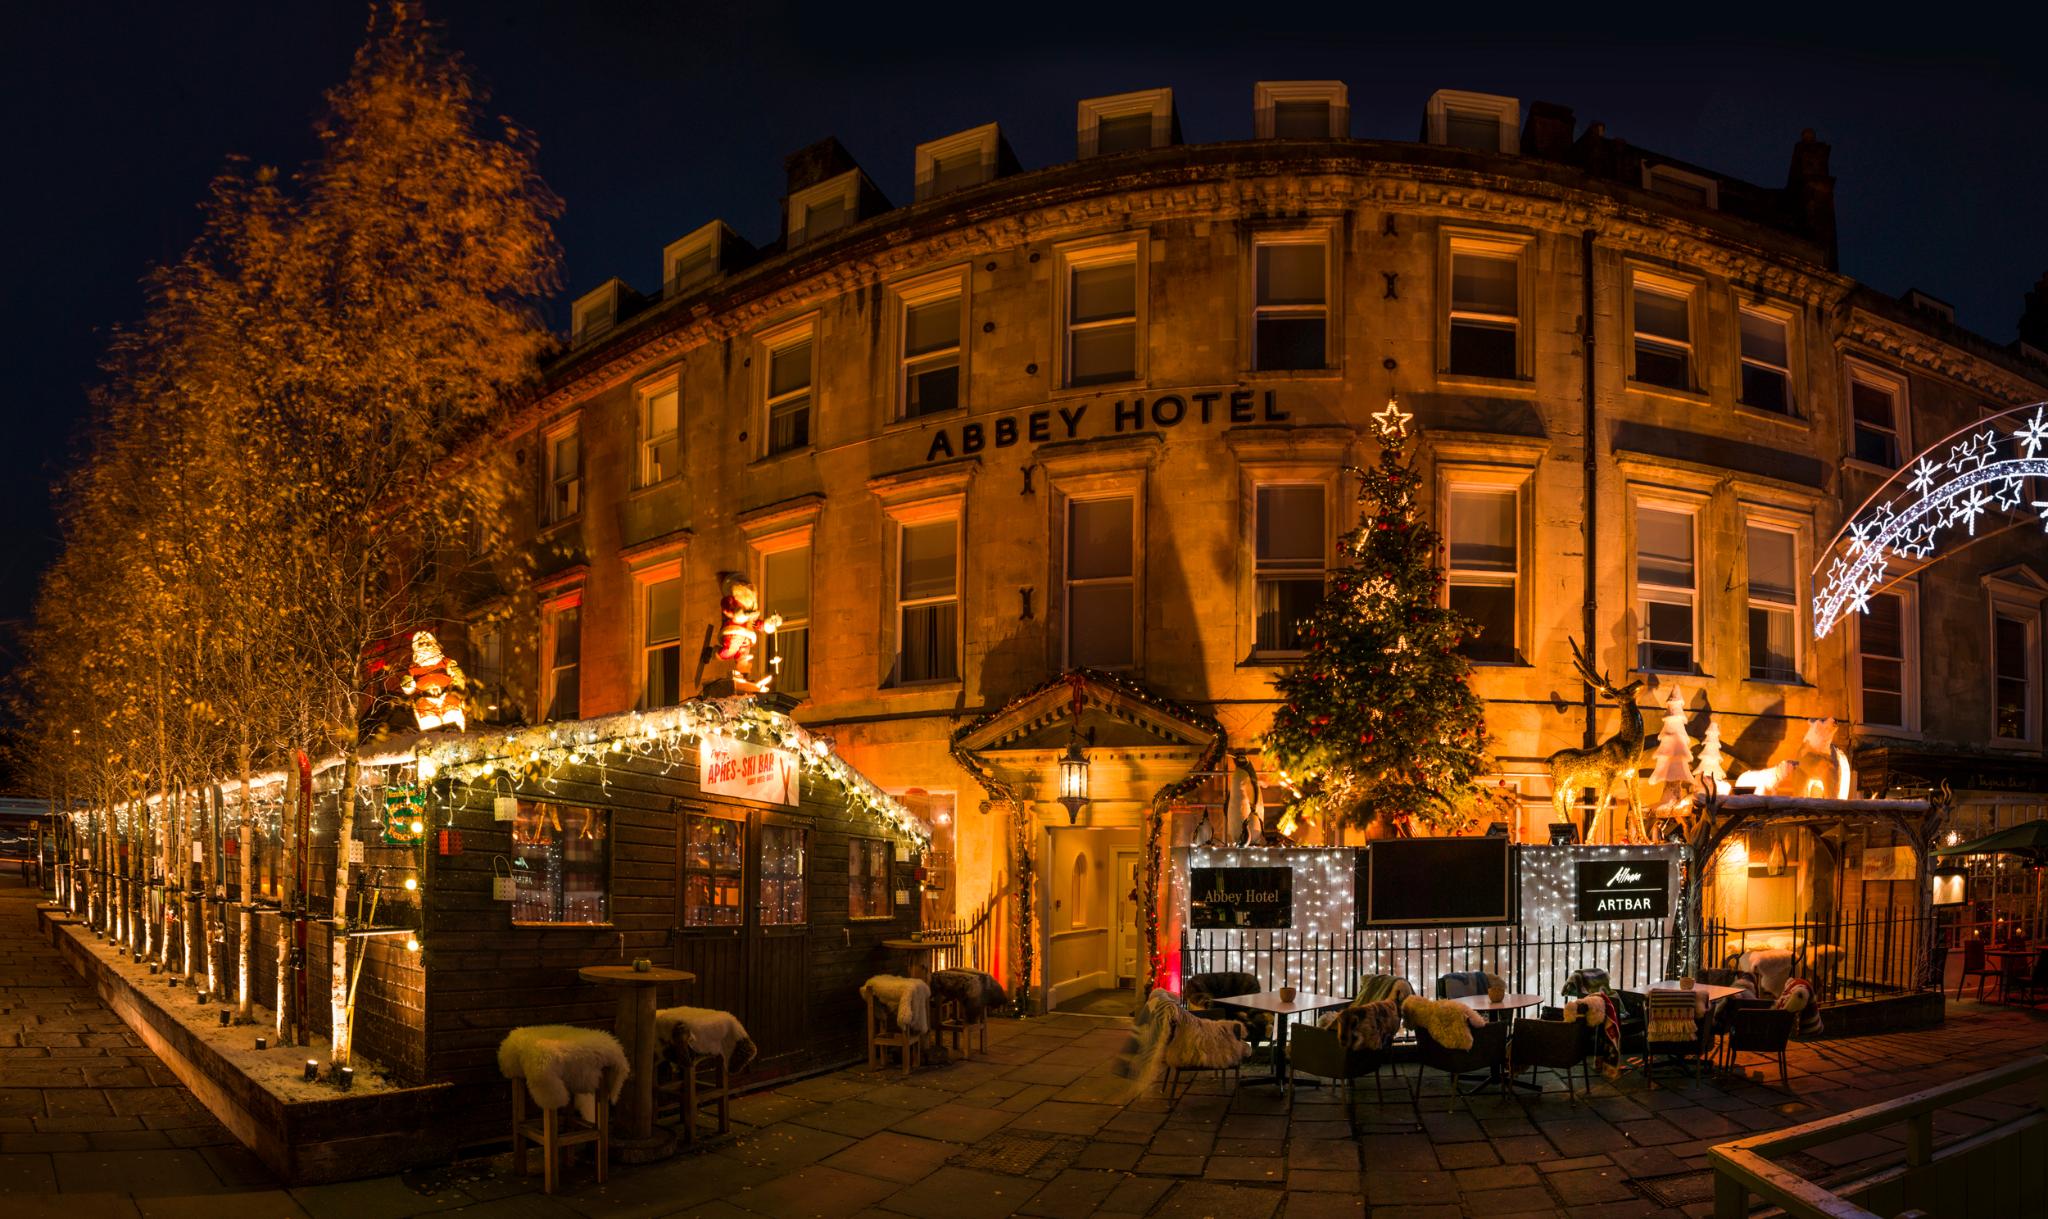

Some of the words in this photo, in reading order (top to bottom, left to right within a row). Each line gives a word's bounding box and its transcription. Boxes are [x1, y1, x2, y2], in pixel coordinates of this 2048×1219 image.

[926, 405, 1087, 461] ABBEY
[1115, 390, 1290, 432] HOTEL
[1205, 889, 1242, 905] Abbey
[1246, 889, 1280, 903] Hotel
[1597, 898, 1652, 911] ARTBAR
